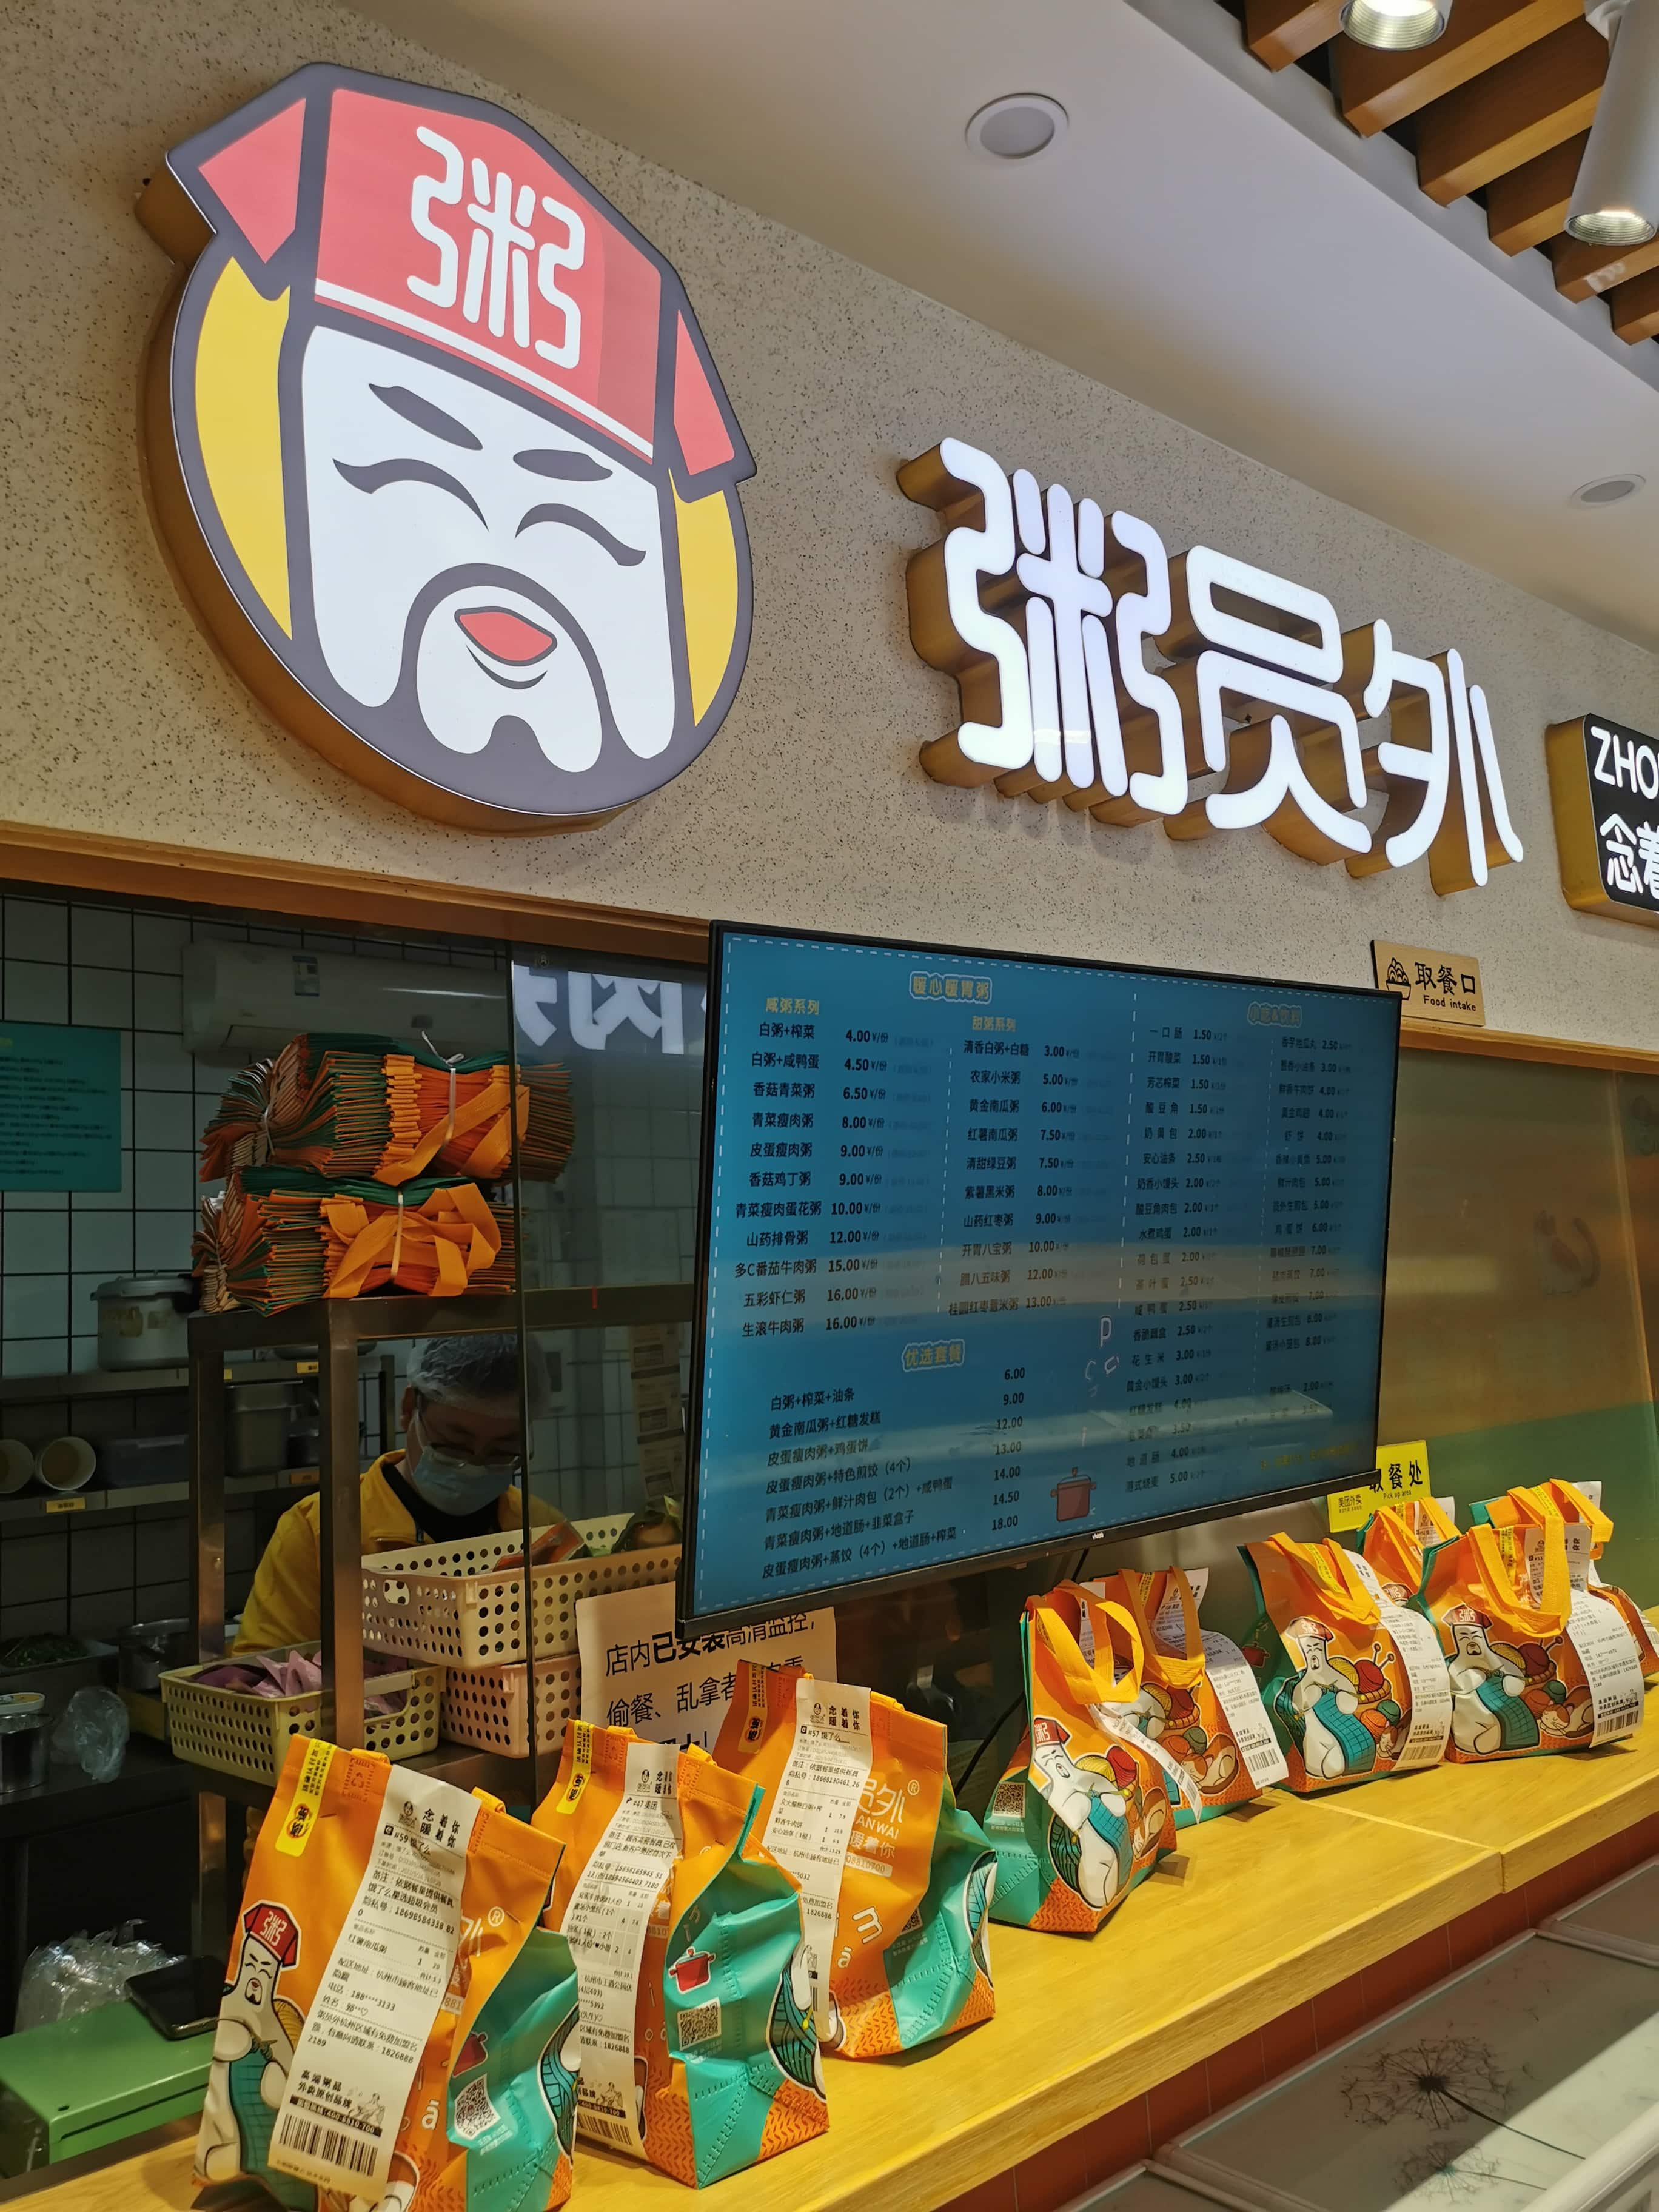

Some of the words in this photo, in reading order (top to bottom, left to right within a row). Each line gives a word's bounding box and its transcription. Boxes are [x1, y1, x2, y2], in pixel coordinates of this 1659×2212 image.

[940, 437, 1523, 886] 粥员外
[1590, 726, 1659, 799] ZHO
[1415, 962, 1476, 995] 取餐口
[912, 974, 989, 1000] 暖心暖胃粥
[766, 997, 819, 1016] 咸粥系列
[1423, 995, 1446, 1007] Food
[1450, 999, 1476, 1011] intake
[759, 1022, 815, 1039] 白粥+榨菜
[963, 1039, 1029, 1057] 清香白粥+白糖
[752, 1051, 819, 1069] 白粥+咸鸭蛋
[971, 1070, 1021, 1085] 农家小米粥
[753, 1082, 815, 1098] 香菇青菜粥
[969, 1098, 1019, 1114] 黄金南瓜粥
[752, 1112, 814, 1128] 青菜瘦肉粥
[967, 1127, 1018, 1142] 红薯南瓜粥
[750, 1142, 813, 1158] 皮蛋瘦肉粥
[965, 1156, 1017, 1170] 清甜绿豆粥
[749, 1171, 811, 1187] 香菇鸡丁粥
[735, 1201, 822, 1218] 青菜瘦肉蛋花粥
[963, 1213, 1014, 1228] 山药红枣粥
[746, 1230, 808, 1247] 山药排骨粥
[734, 1259, 817, 1278] 多C番茄牛肉粥
[743, 1290, 806, 1308] 五彩虾仁粥
[742, 1318, 805, 1338] 生滚牛肉粥
[905, 1343, 962, 1368] 优选套餐
[771, 1388, 855, 1412] 白粥+榨菜+油条
[1004, 1368, 1025, 1381] 6.00
[1003, 1393, 1024, 1406] 9.00
[997, 1416, 1024, 1430] 12.00
[995, 1441, 1022, 1456] 13.00
[993, 1466, 1021, 1481] 14.00
[992, 1491, 1019, 1506] 14.50
[991, 1517, 1018, 1532] 18.00
[808, 1729, 820, 1738] #57
[856, 1815, 899, 1840] ANWAI
[394, 1832, 409, 1843] #59
[850, 1830, 896, 1858] 暖着你
[307, 2035, 326, 2047] 2189
